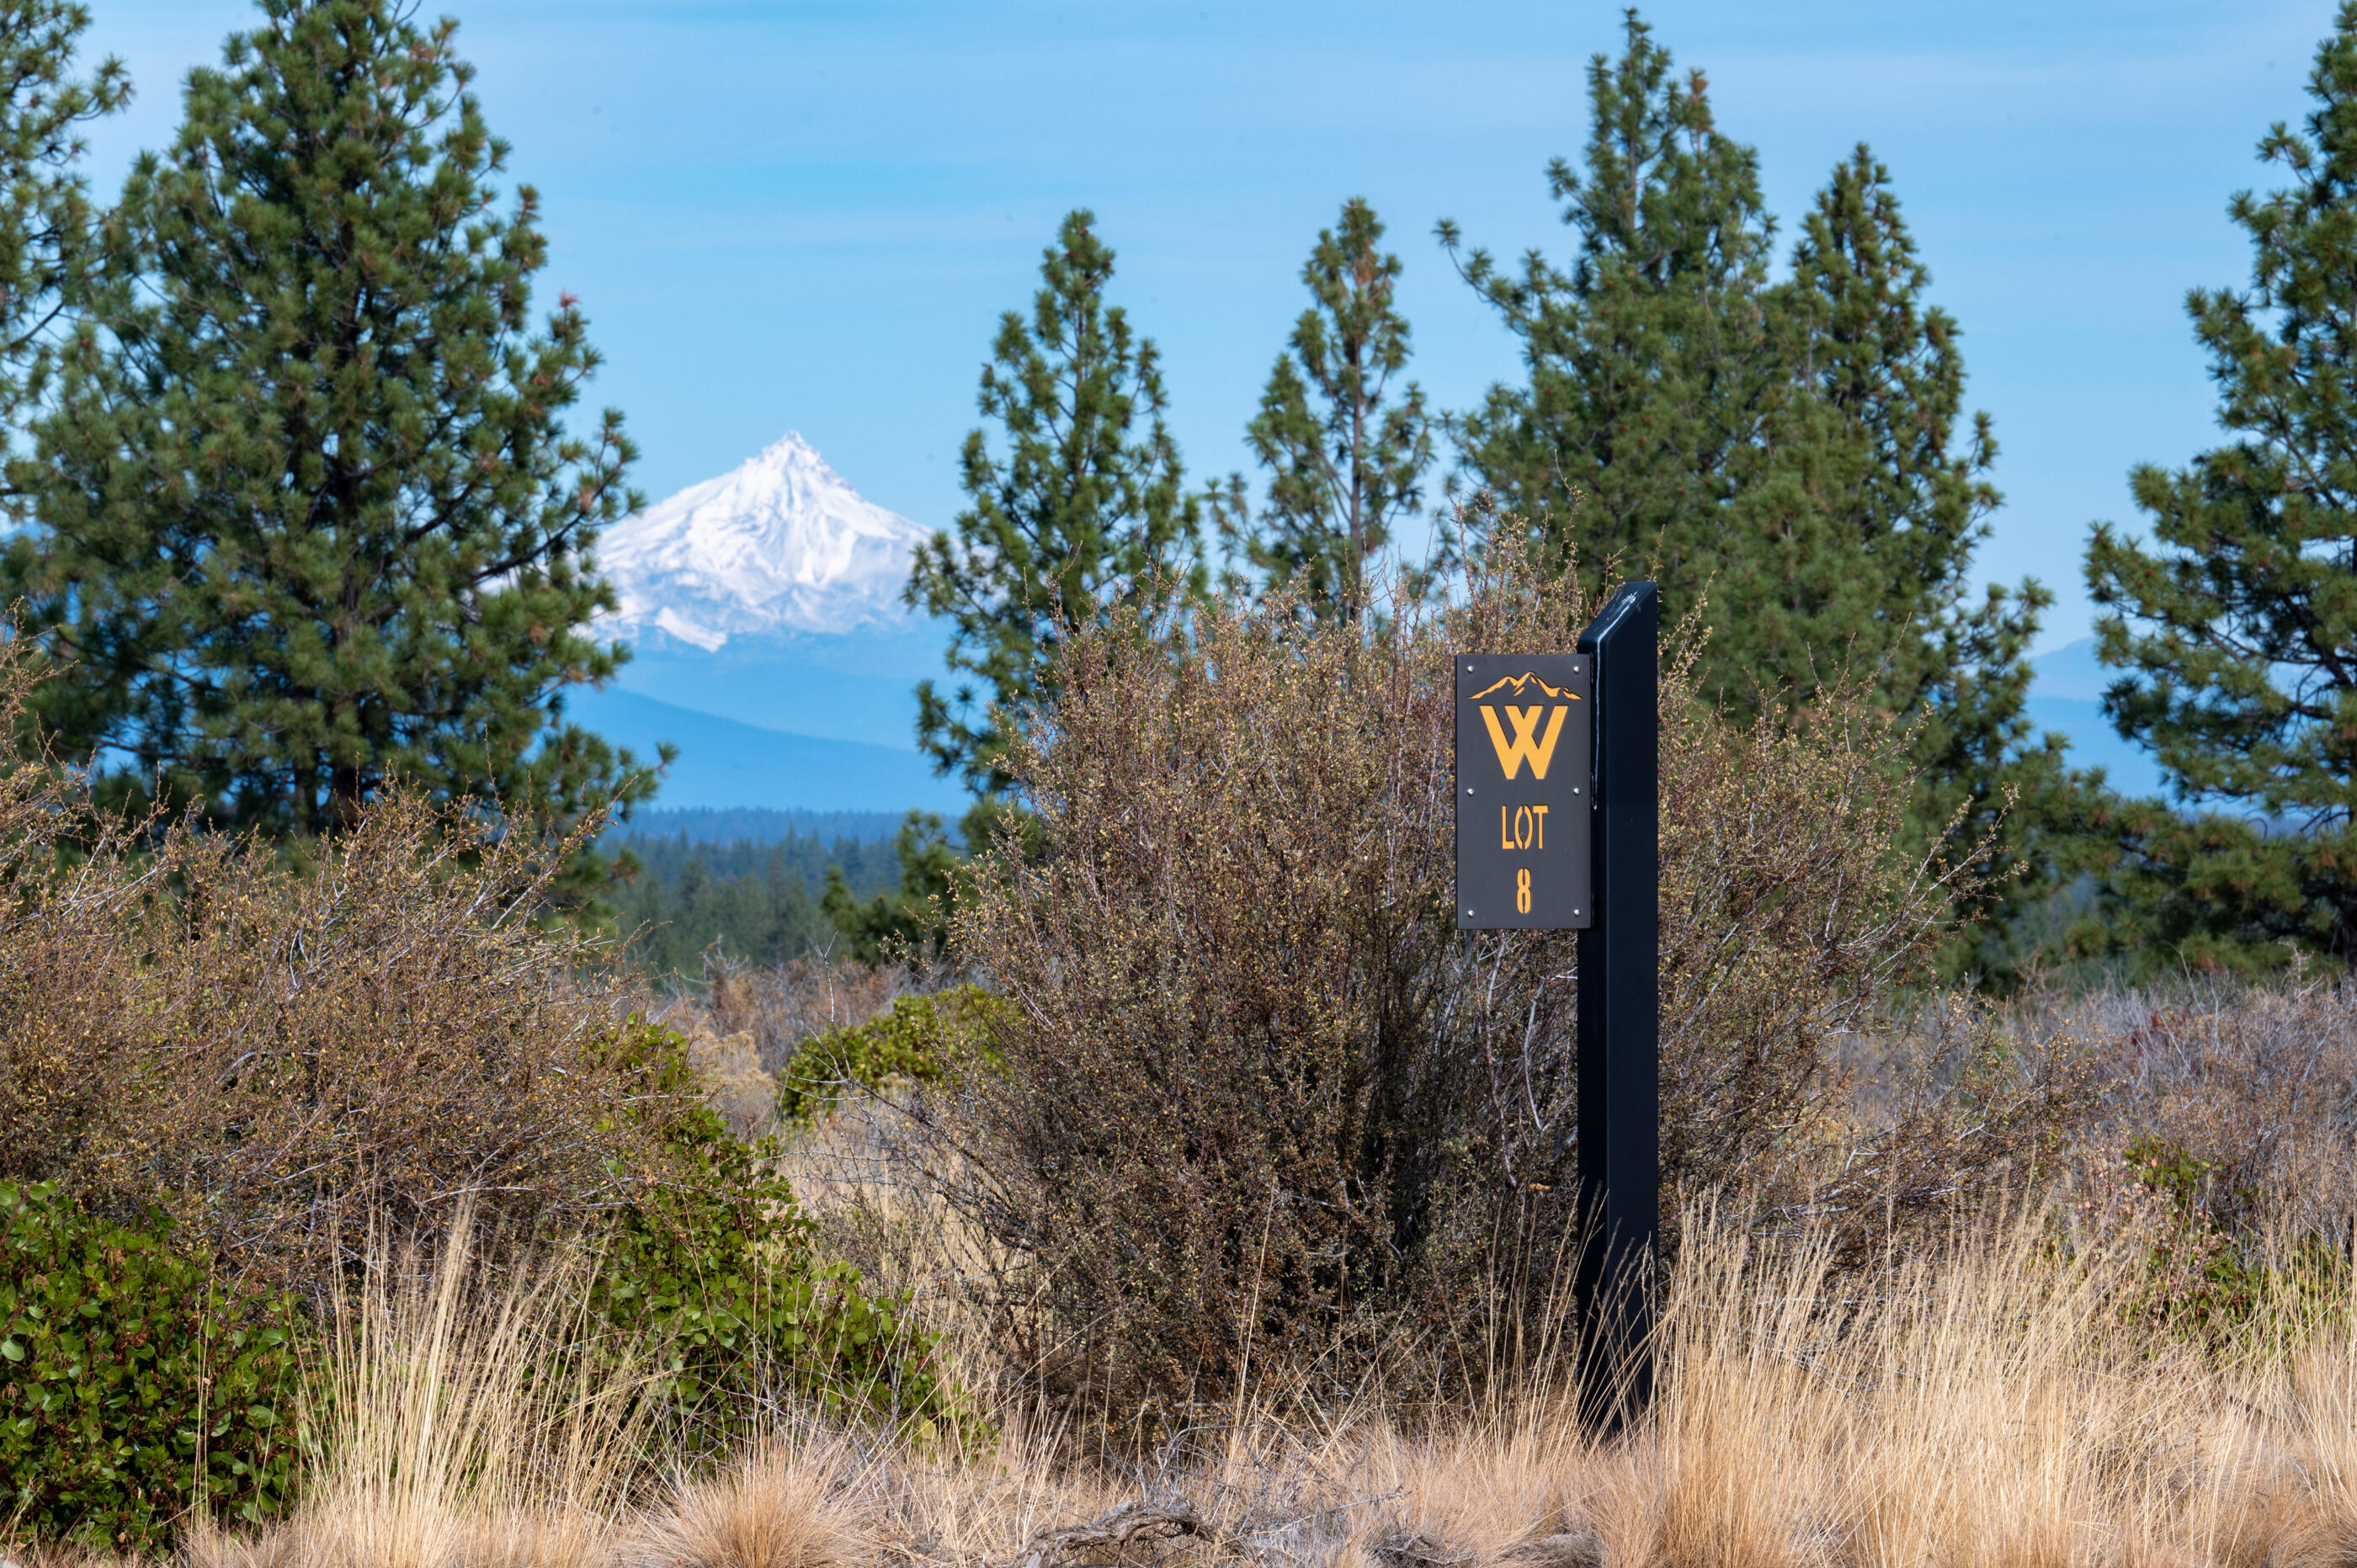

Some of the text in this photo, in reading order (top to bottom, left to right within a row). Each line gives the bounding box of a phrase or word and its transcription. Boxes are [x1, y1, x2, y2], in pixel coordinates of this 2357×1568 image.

[1479, 704, 1569, 780] W
[1501, 804, 1549, 850] LOT
[1516, 867, 1532, 914] 8
